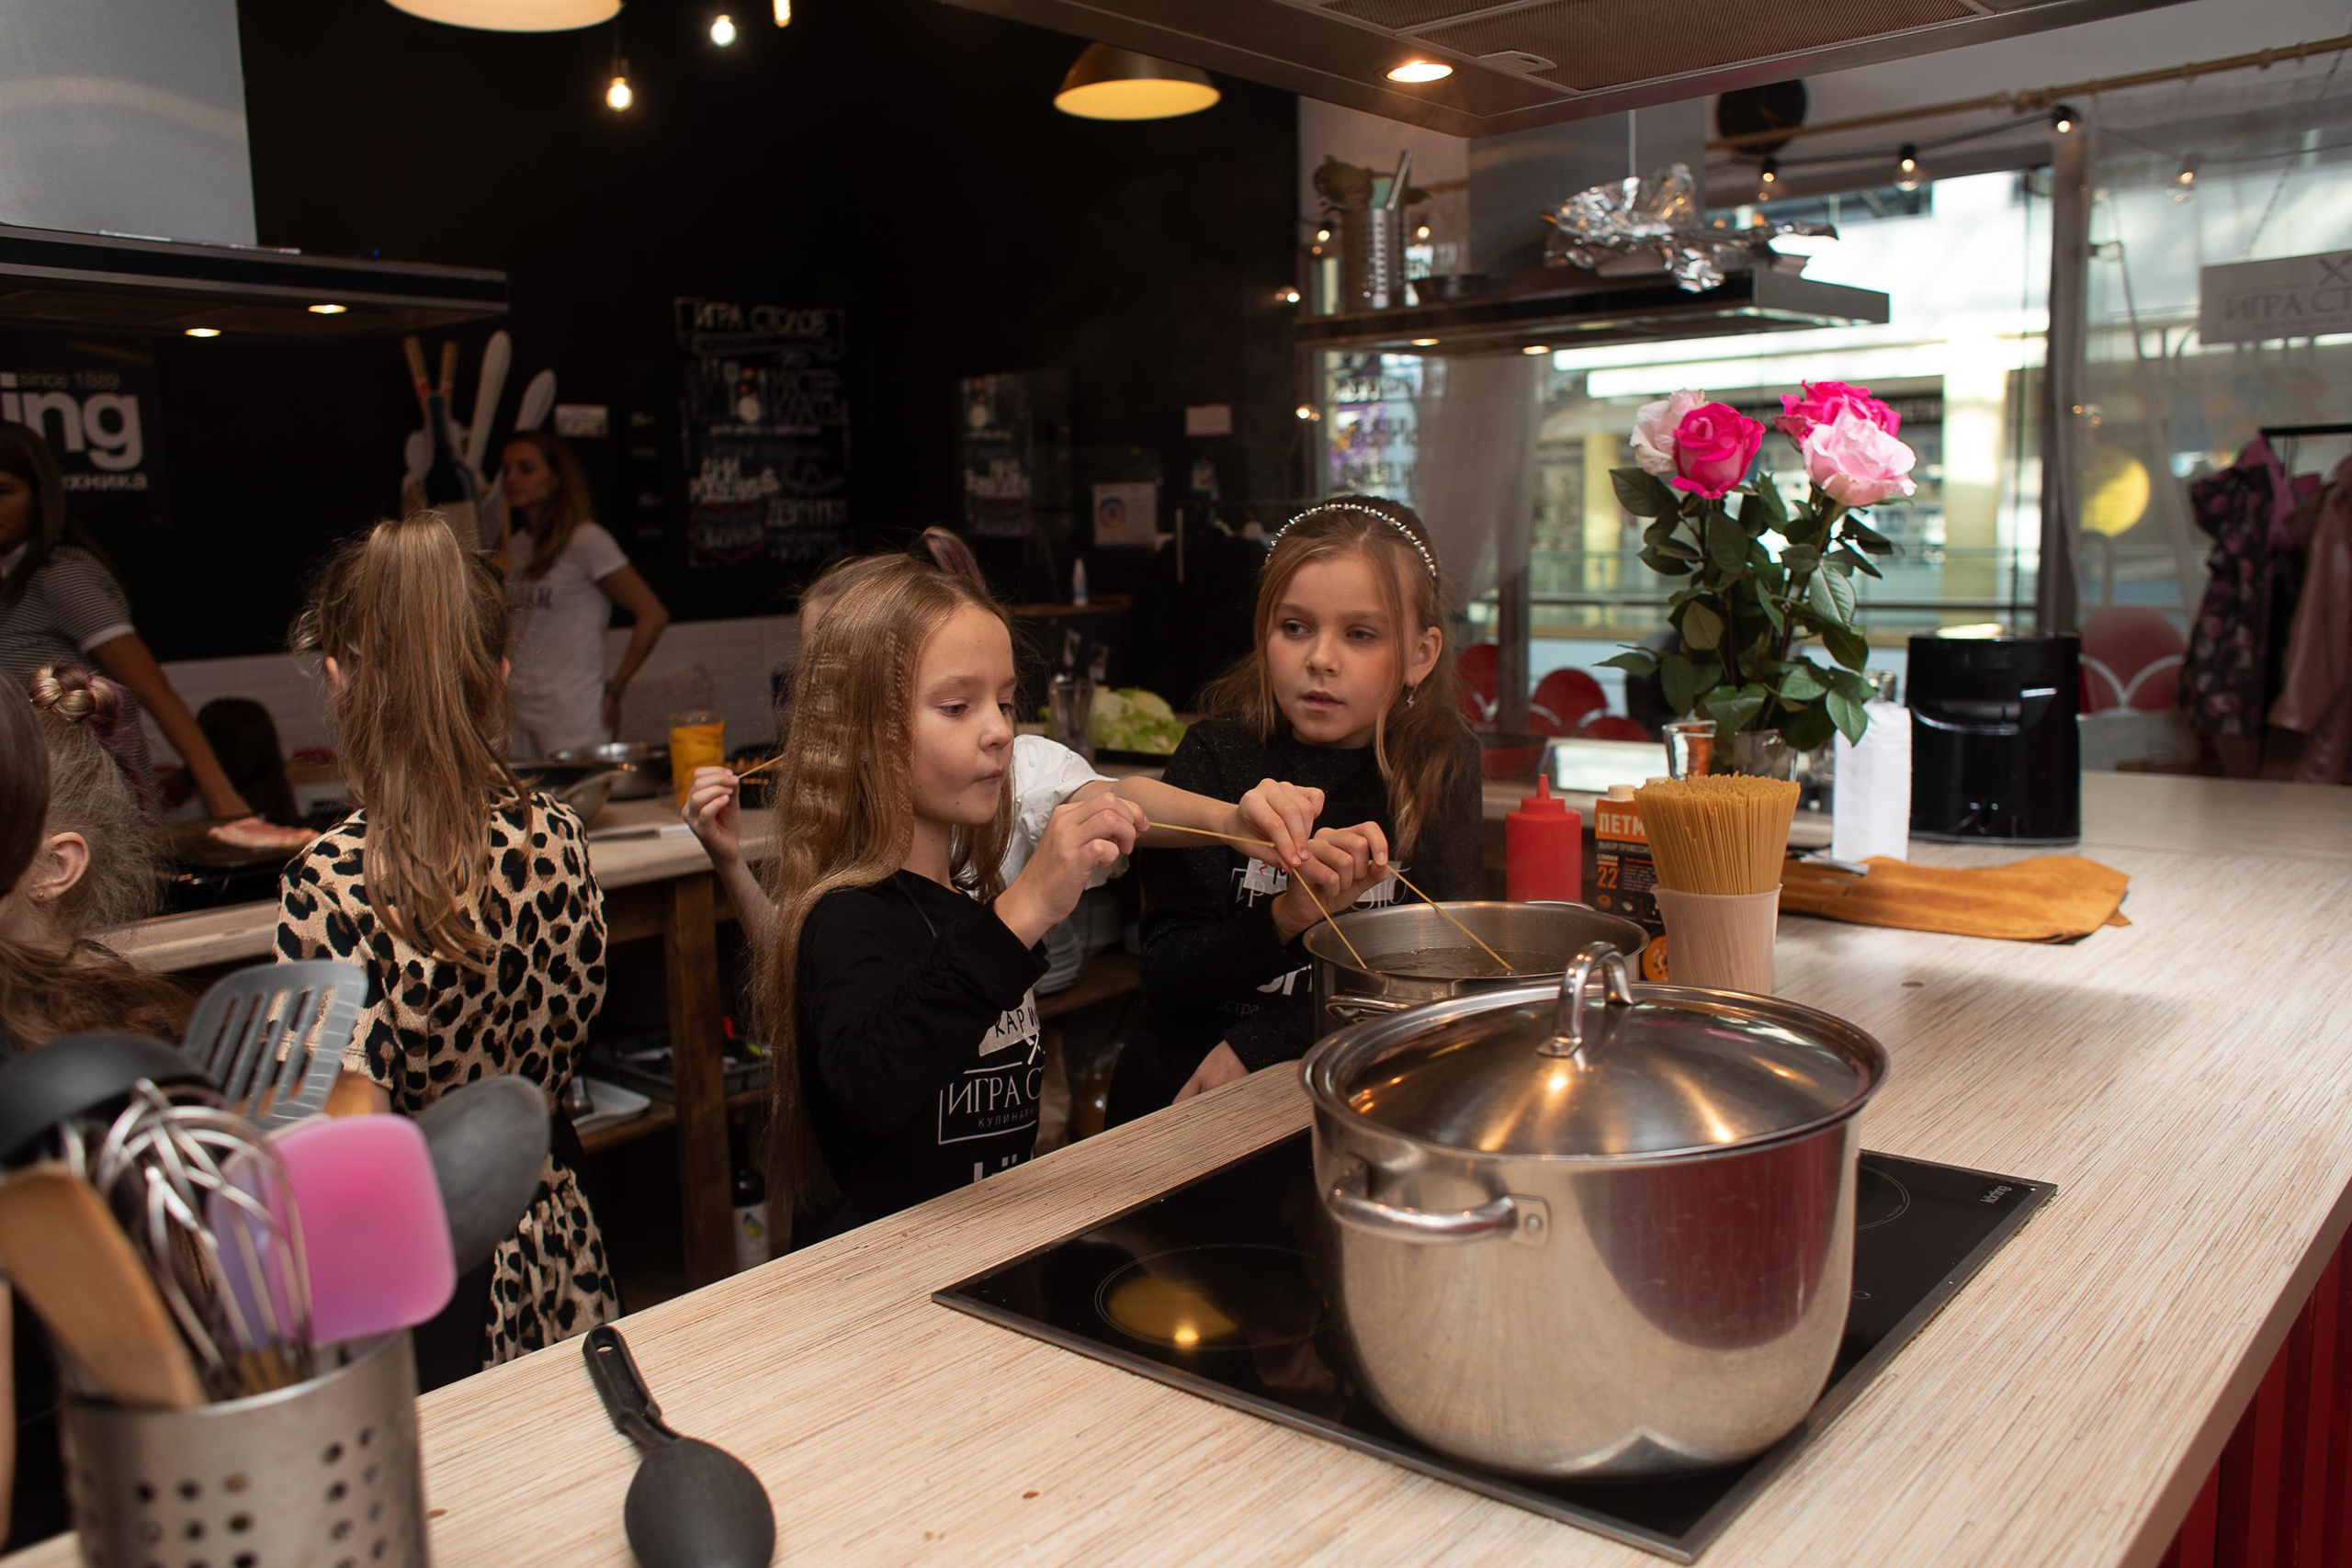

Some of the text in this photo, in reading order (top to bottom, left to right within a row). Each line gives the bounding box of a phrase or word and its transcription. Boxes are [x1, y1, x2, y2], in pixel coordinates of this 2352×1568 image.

[19, 373, 68, 388] since
[1597, 865, 1619, 889] 22
[949, 1074, 1022, 1115] ИГРА
